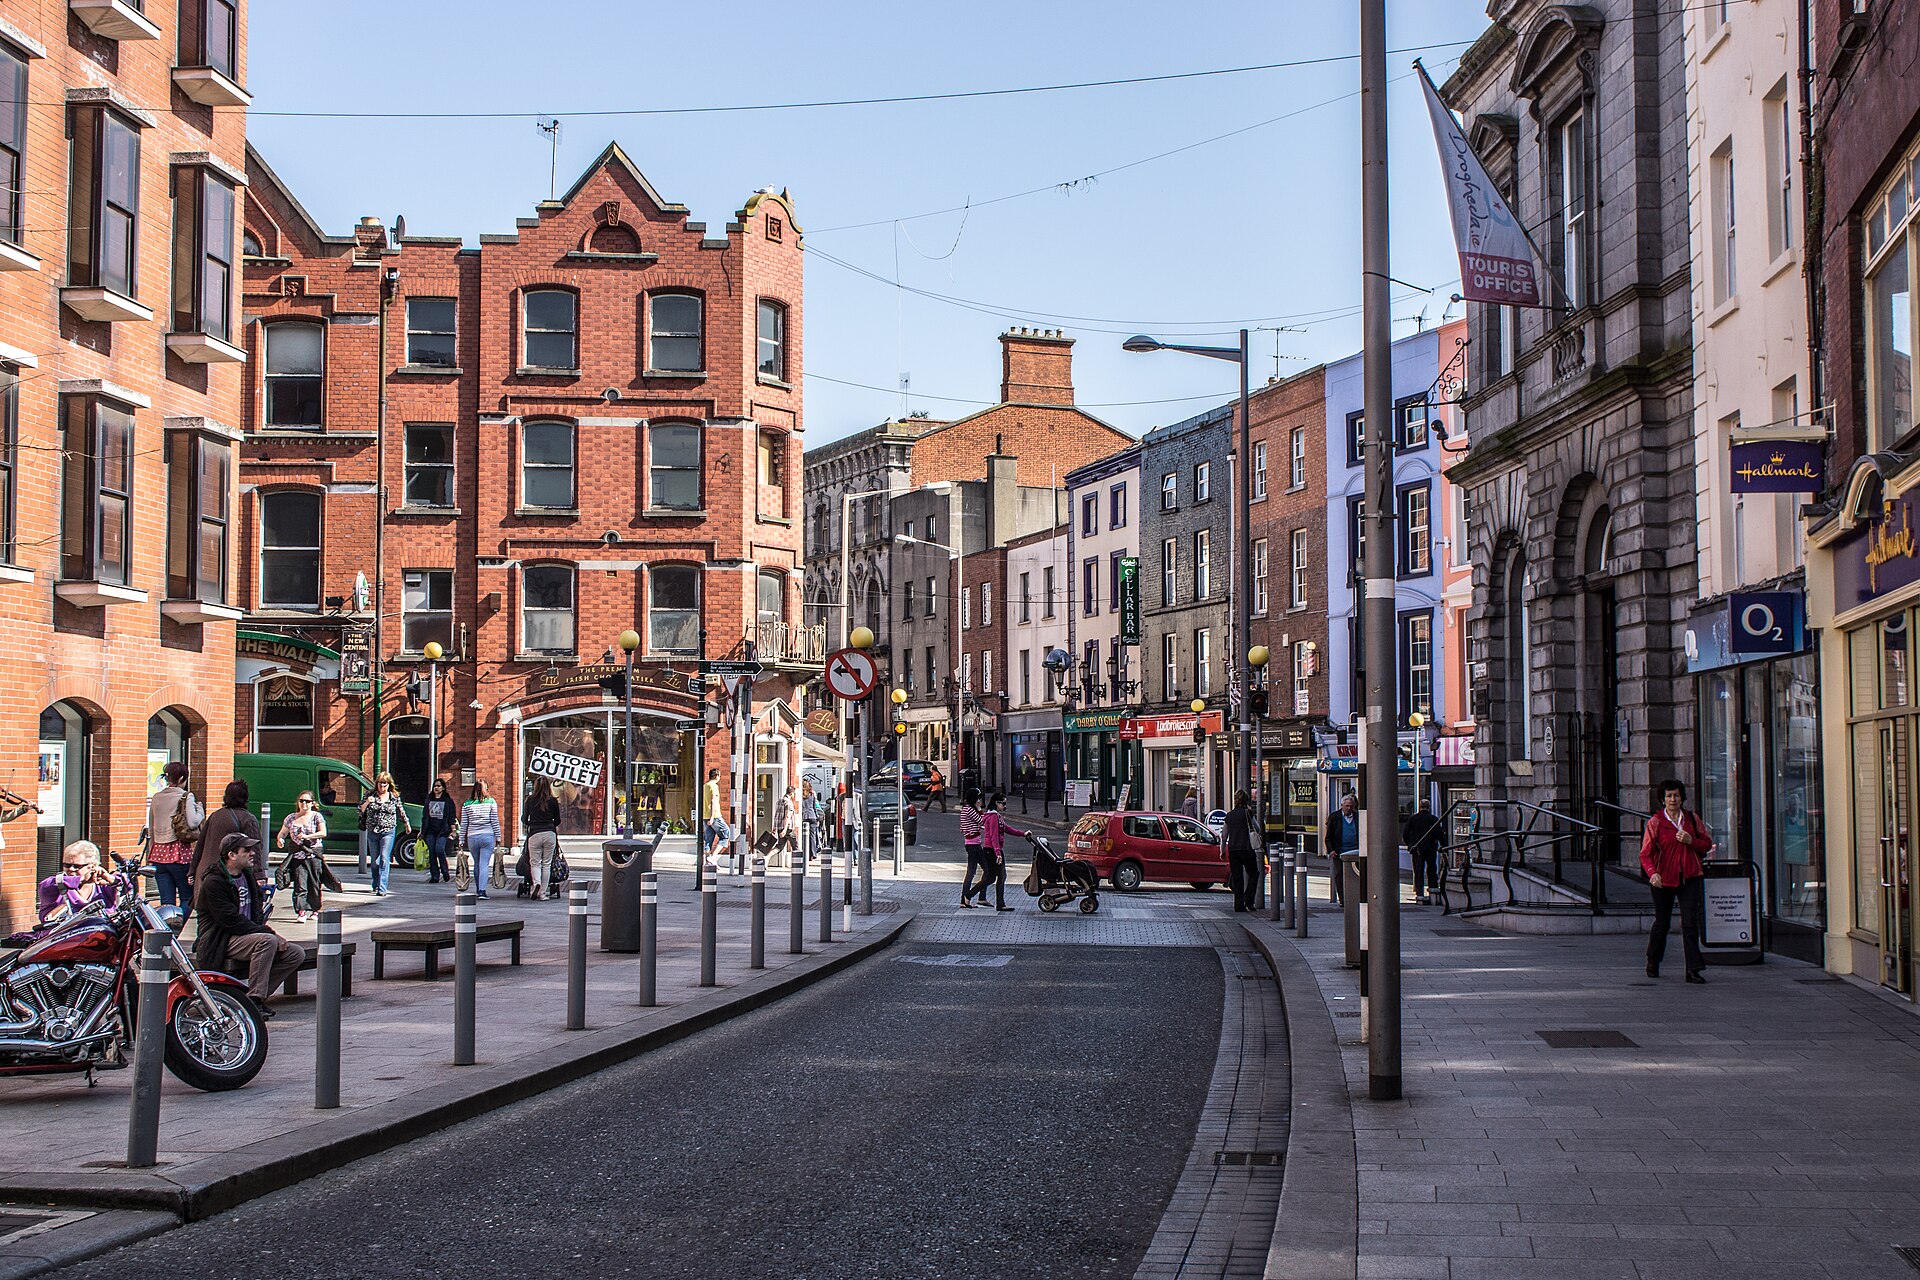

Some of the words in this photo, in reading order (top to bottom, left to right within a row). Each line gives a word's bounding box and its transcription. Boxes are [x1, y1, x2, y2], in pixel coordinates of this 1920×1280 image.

[1448, 132, 1489, 248] Drogheda.ie
[1467, 256, 1534, 279] TOURIST
[1473, 275, 1533, 295] OFFICE
[1736, 461, 1819, 484] Hallmark
[1865, 502, 1915, 594] Hallmark
[1125, 568, 1134, 611] CELLAR
[1126, 612, 1135, 633] BAR
[236, 638, 268, 654] THE
[273, 643, 317, 665] WALL
[566, 675, 589, 684] IRISH
[600, 666, 640, 674] PREMIM
[810, 712, 836, 732] Lir
[1076, 717, 1098, 728] DARBY
[555, 728, 581, 748] Lir
[1261, 735, 1281, 744] oldsmiths
[534, 748, 601, 771] FACTORY
[532, 758, 599, 785] OUTLET
[1298, 786, 1313, 796] GOLD
